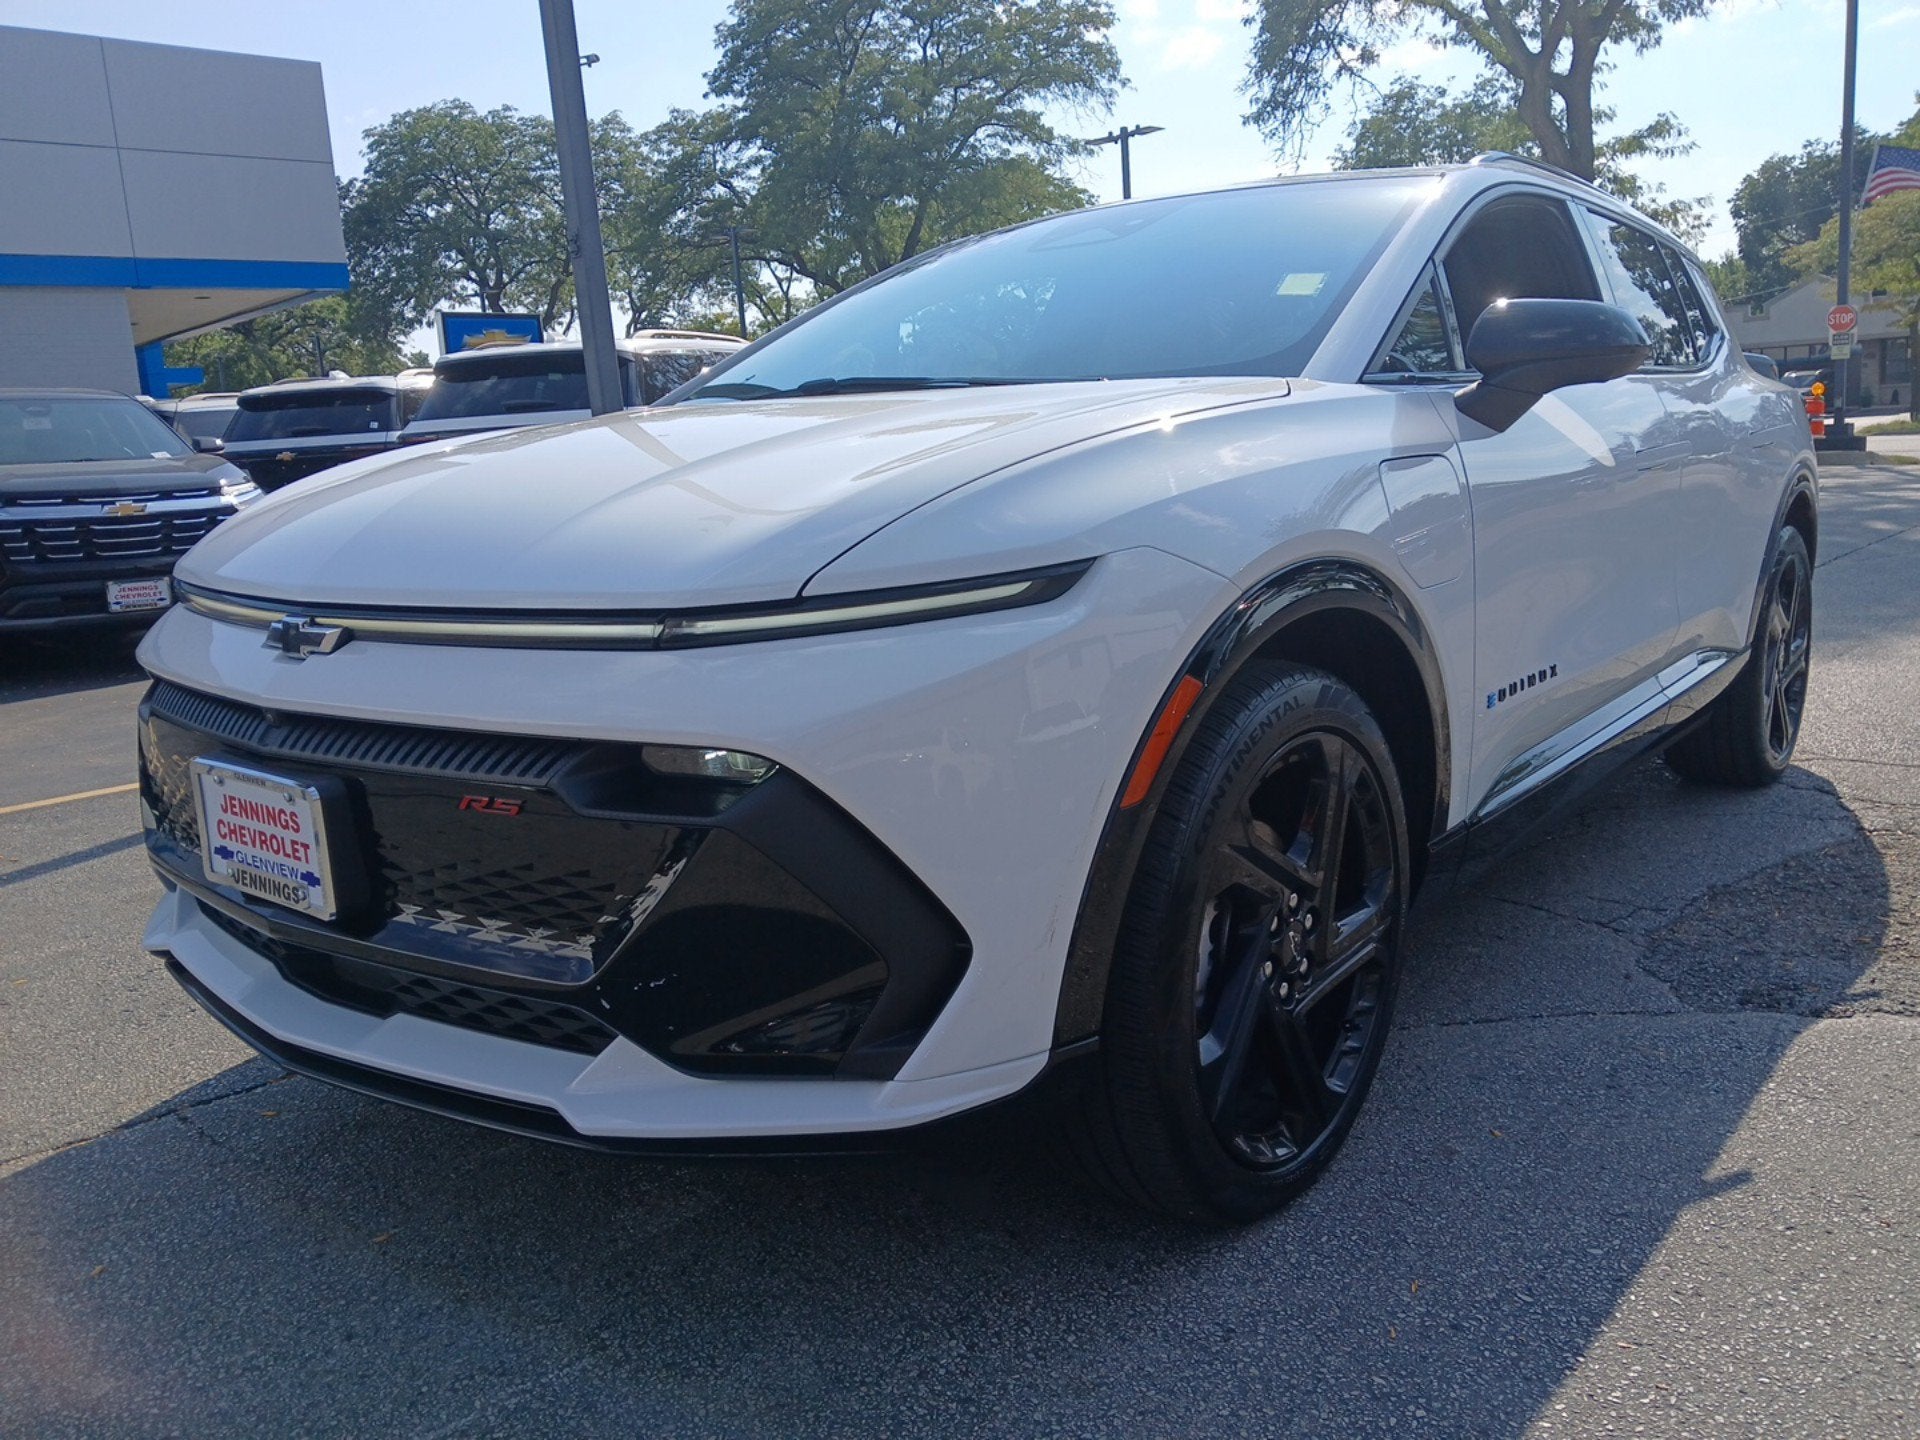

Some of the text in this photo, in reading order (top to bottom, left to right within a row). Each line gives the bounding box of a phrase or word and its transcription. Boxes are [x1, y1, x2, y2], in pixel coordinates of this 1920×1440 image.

[1829, 313, 1853, 324] STOP
[114, 591, 162, 600] CHEVROLET
[118, 585, 159, 593] JENNINGS
[1486, 664, 1558, 709] EQUINOX
[1195, 694, 1306, 854] CONTINENTAL
[220, 793, 301, 834] JENNINGS
[459, 796, 521, 816] RS
[216, 818, 310, 865] CHEVROLET
[235, 849, 300, 880] GLENVIEW
[232, 866, 302, 905] JENNINGS
